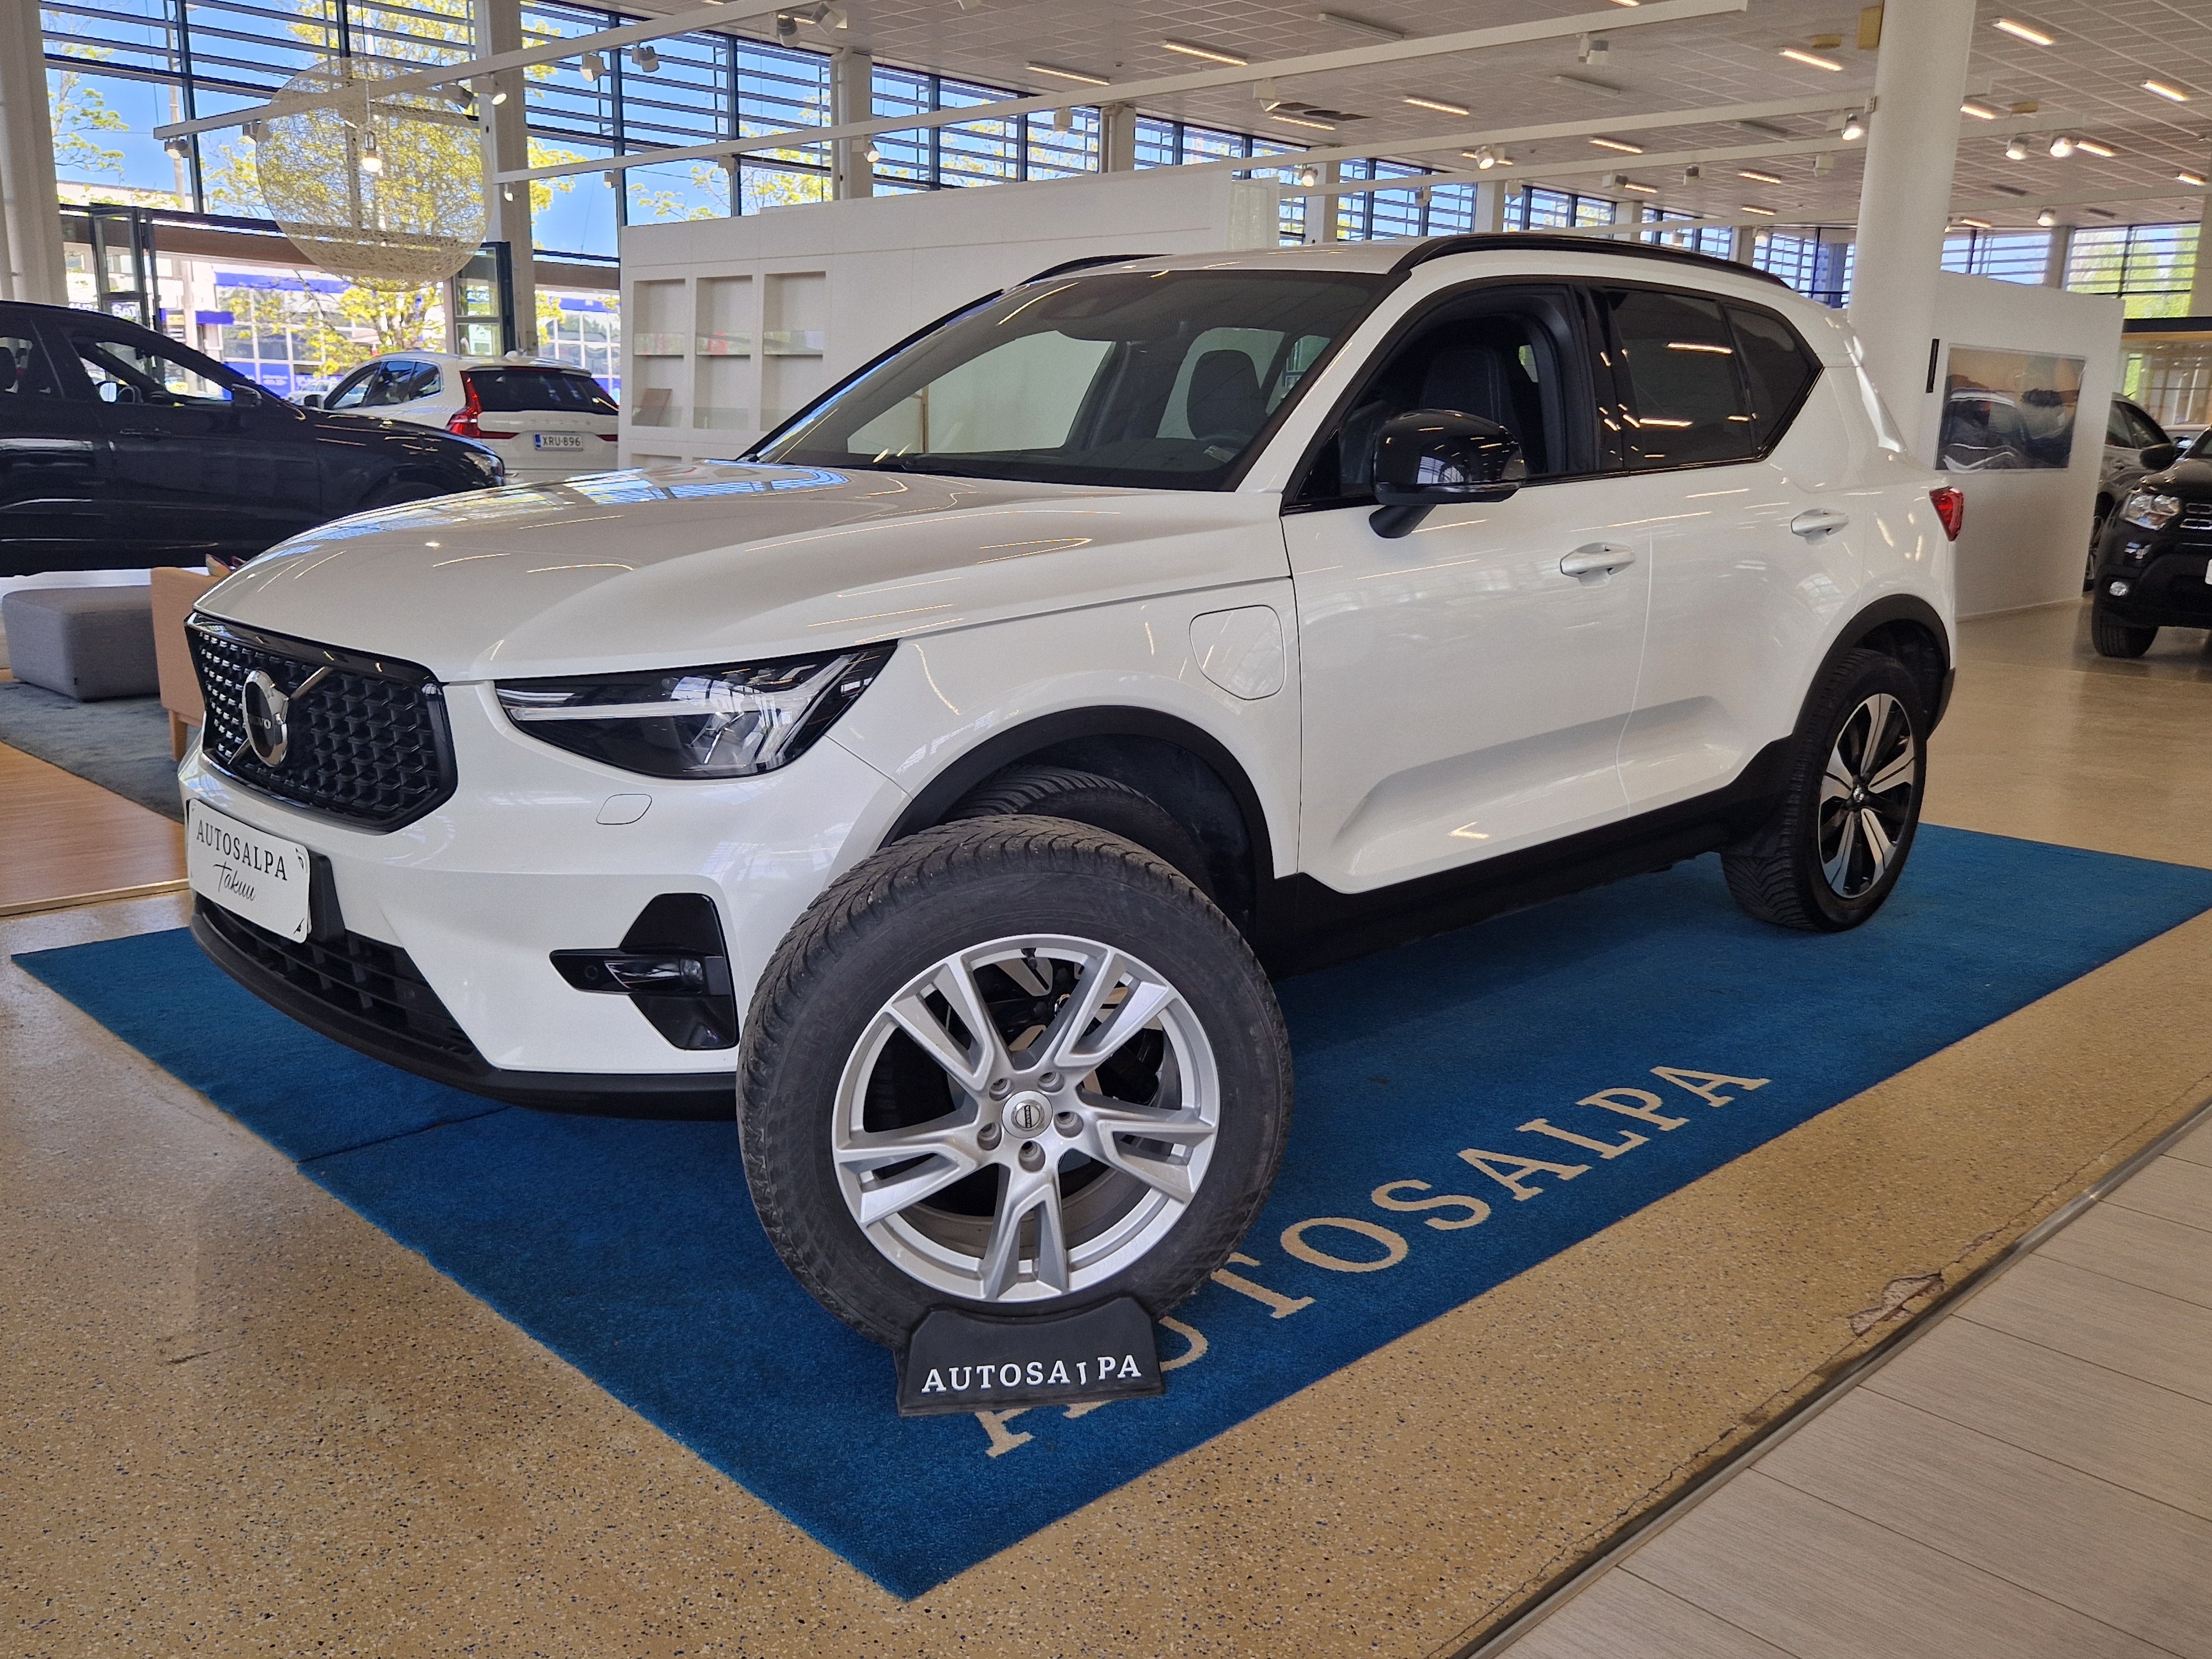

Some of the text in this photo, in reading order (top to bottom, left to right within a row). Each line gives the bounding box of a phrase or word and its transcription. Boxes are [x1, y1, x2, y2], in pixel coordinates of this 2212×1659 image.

[542, 436, 581, 446] XRU-896
[196, 819, 288, 881] AUTOSALPA
[213, 861, 255, 901] Takuu
[985, 1065, 1771, 1458] TOSALPA
